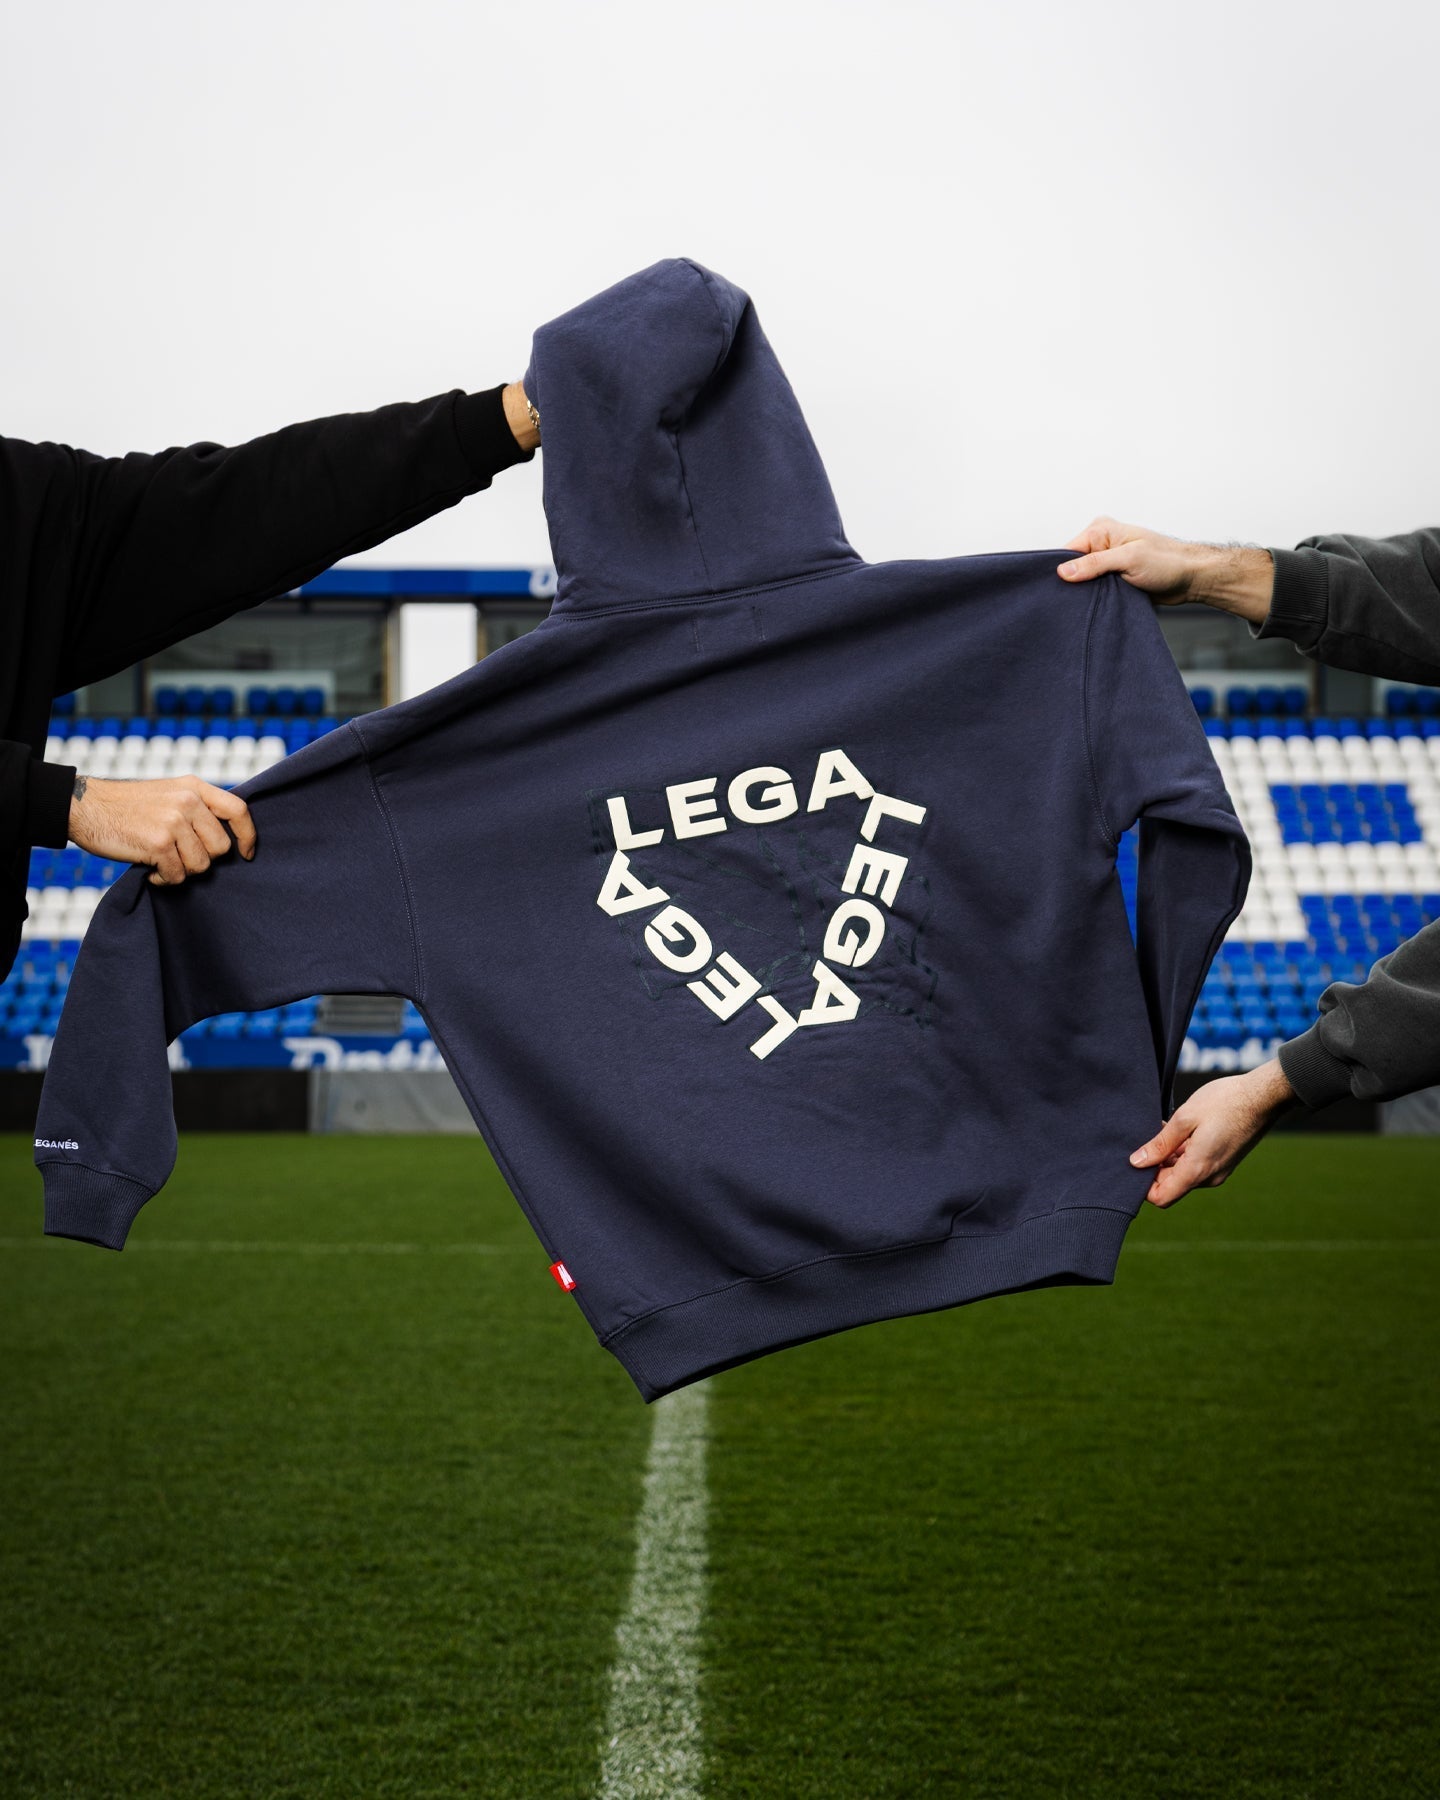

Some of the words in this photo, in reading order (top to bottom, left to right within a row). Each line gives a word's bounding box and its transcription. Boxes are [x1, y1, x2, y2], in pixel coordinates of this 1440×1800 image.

[606, 749, 876, 851] LEGA
[596, 849, 799, 1061] LEGA
[798, 792, 927, 1027] LEGA
[33, 1138, 79, 1150] EGANÉS
